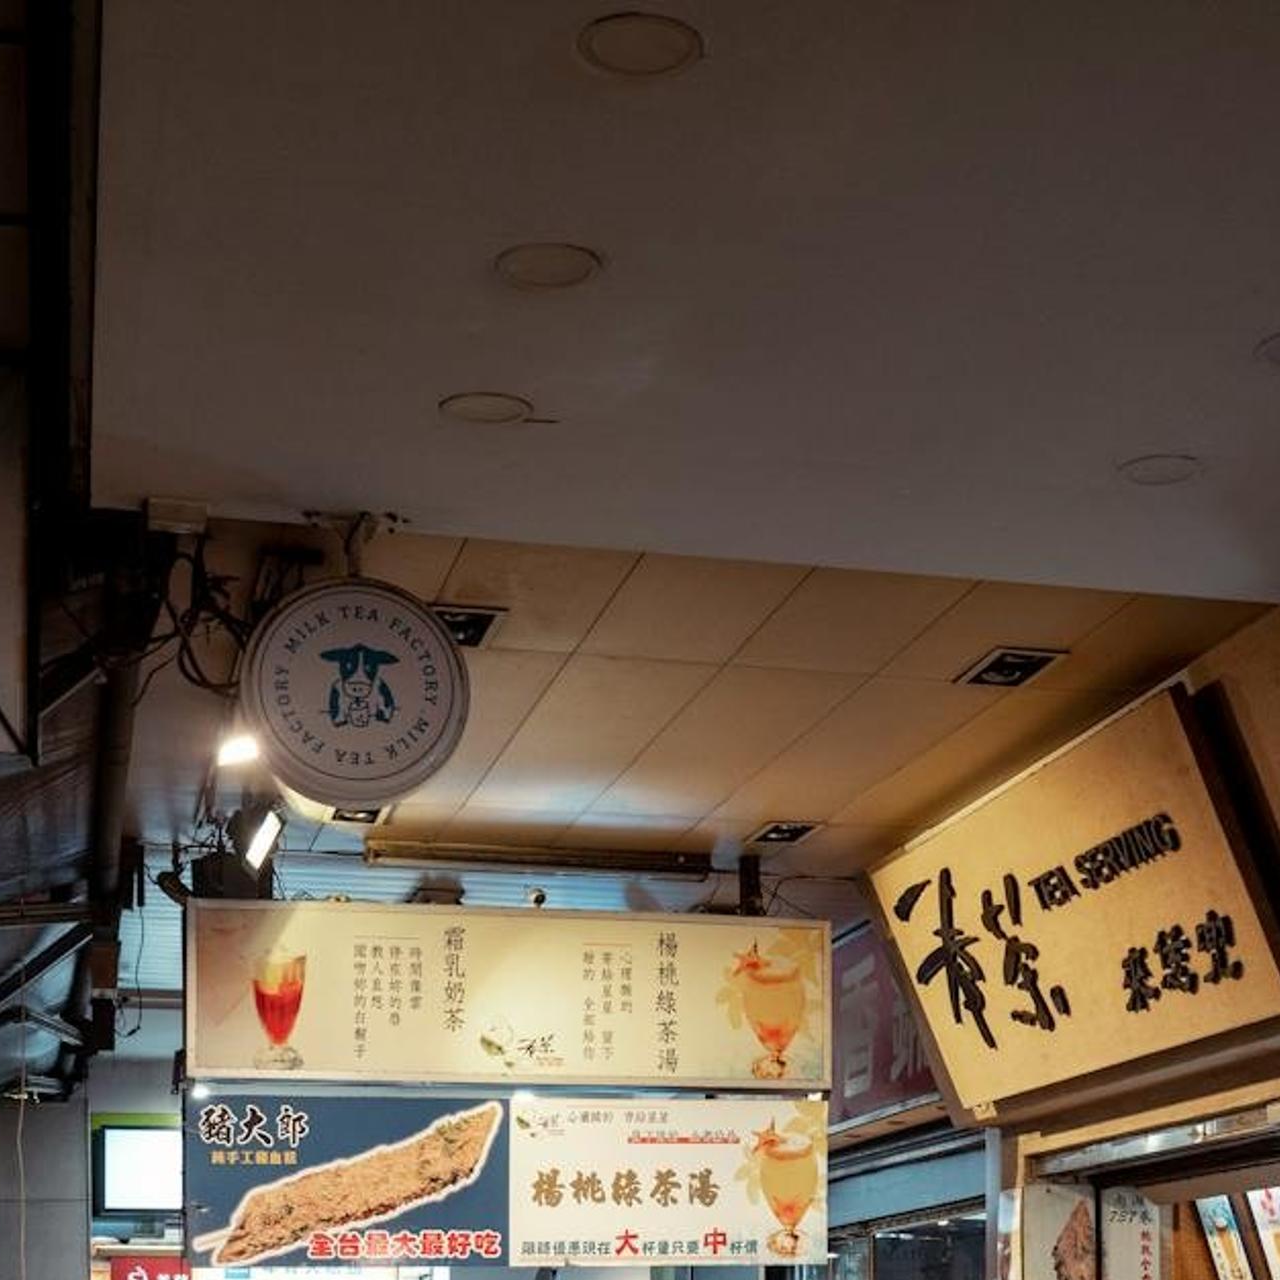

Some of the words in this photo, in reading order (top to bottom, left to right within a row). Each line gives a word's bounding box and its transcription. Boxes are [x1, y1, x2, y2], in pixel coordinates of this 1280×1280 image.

[286, 612, 330, 654] MILK
[337, 604, 379, 622] TEA
[388, 617, 439, 707] FACTORY
[274, 665, 323, 755] FACTORY
[334, 749, 376, 765] TEA
[385, 717, 430, 761] MILK
[1028, 865, 1081, 911] TEA
[1074, 813, 1182, 890] SERVING
[655, 932, 679, 1073] 楊桃綠茶湯
[200, 1104, 309, 1146] 豬大郎
[531, 1167, 721, 1208] 楊桃綠茶湯
[309, 1231, 501, 1258] 全台最大最好吃
